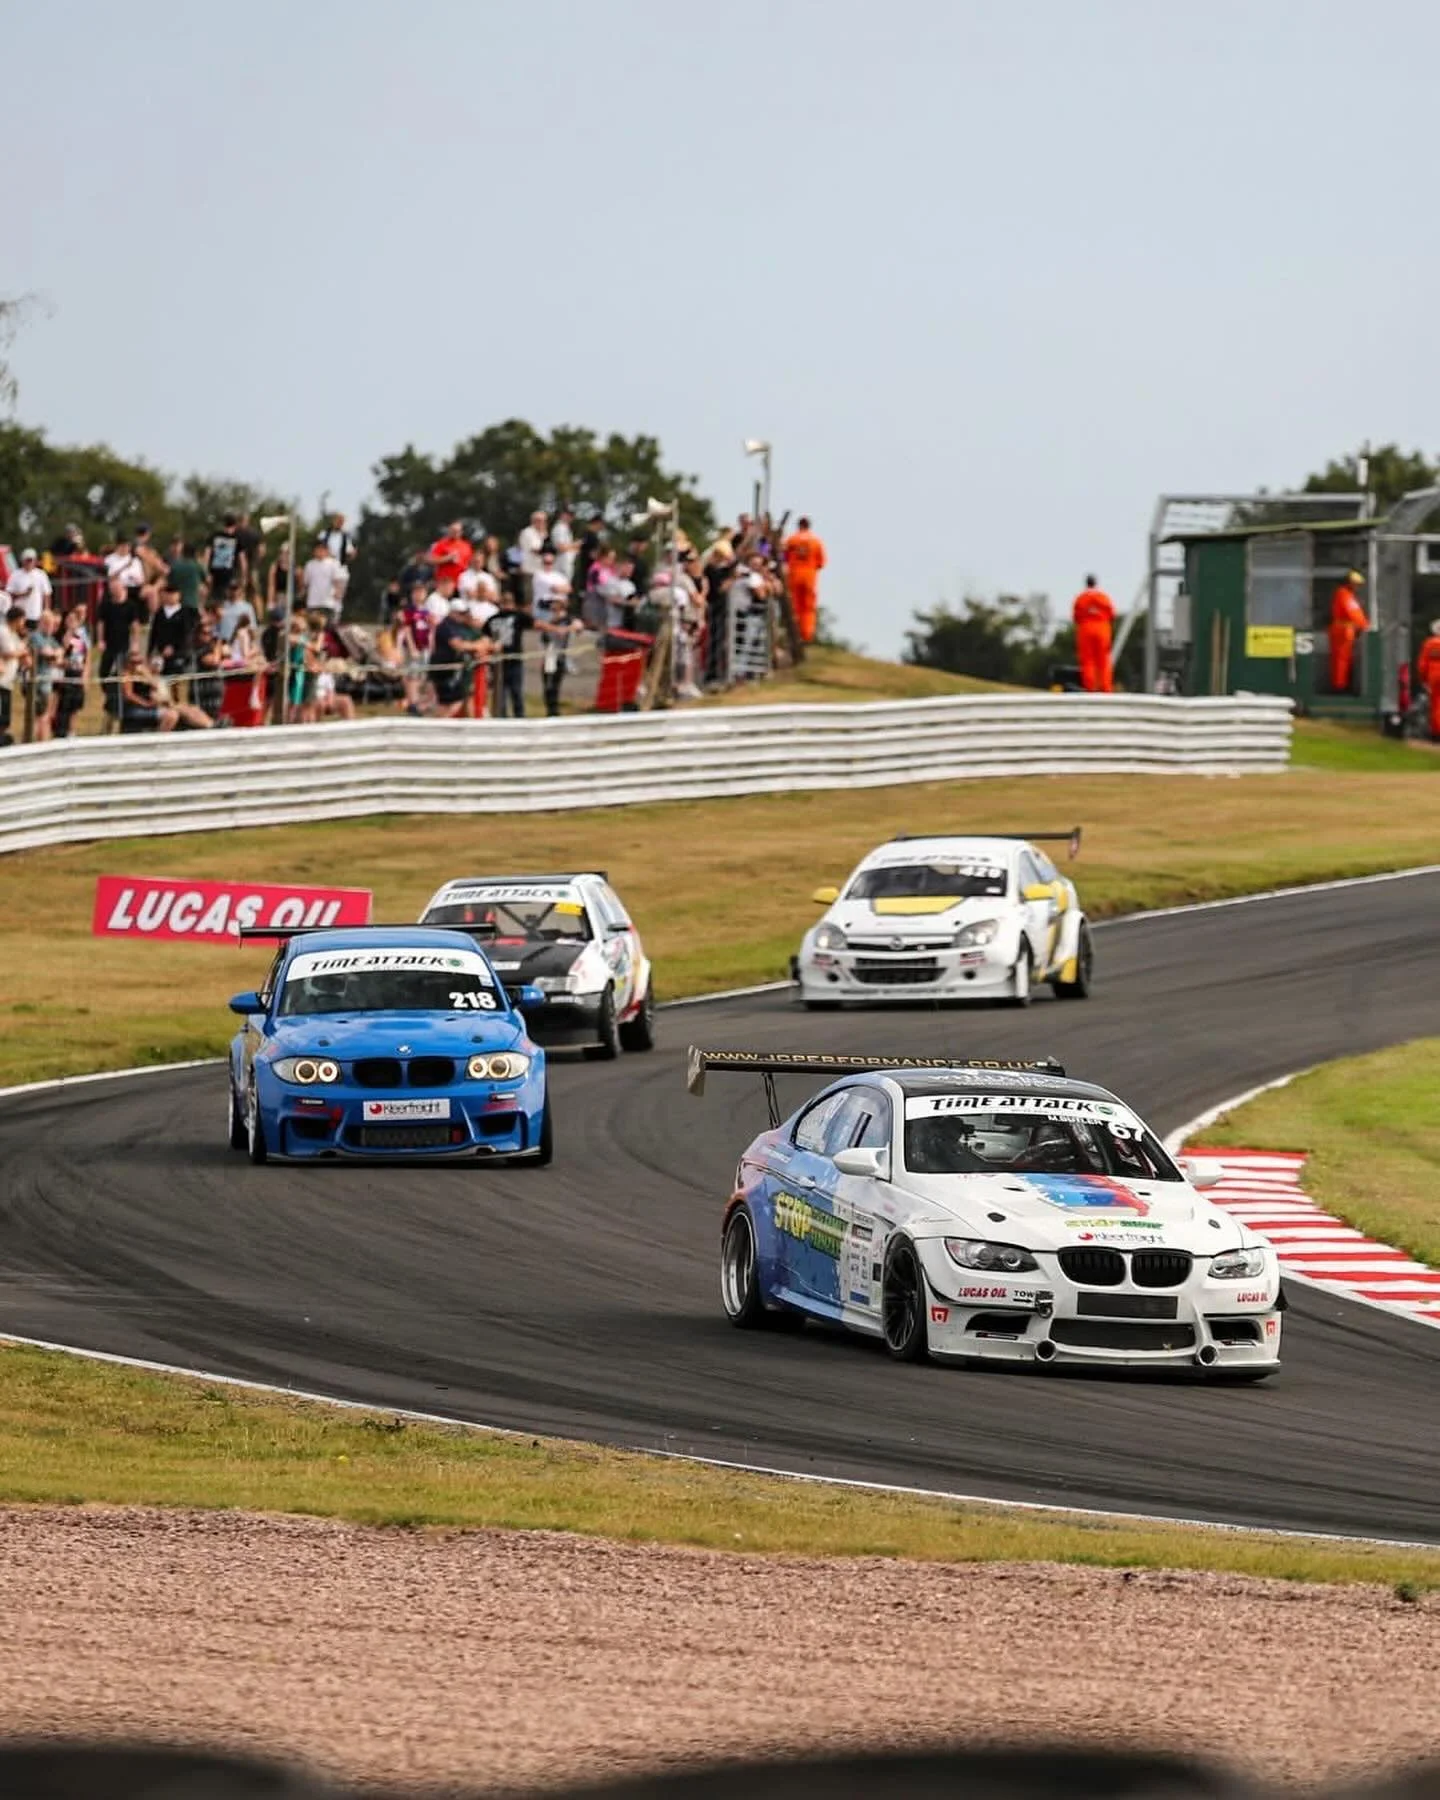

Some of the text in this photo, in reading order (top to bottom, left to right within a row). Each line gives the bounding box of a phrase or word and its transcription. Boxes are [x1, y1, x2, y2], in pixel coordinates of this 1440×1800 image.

[107, 889, 264, 935] LUCAS
[311, 956, 365, 972] TIME
[365, 955, 444, 966] ATTACK
[449, 992, 497, 1009] 218
[930, 1096, 1091, 1112] TIME ATTACK
[1107, 1121, 1145, 1142] 67
[958, 1287, 1007, 1298] LUCAS OIL
[1014, 1289, 1034, 1298] TOW
